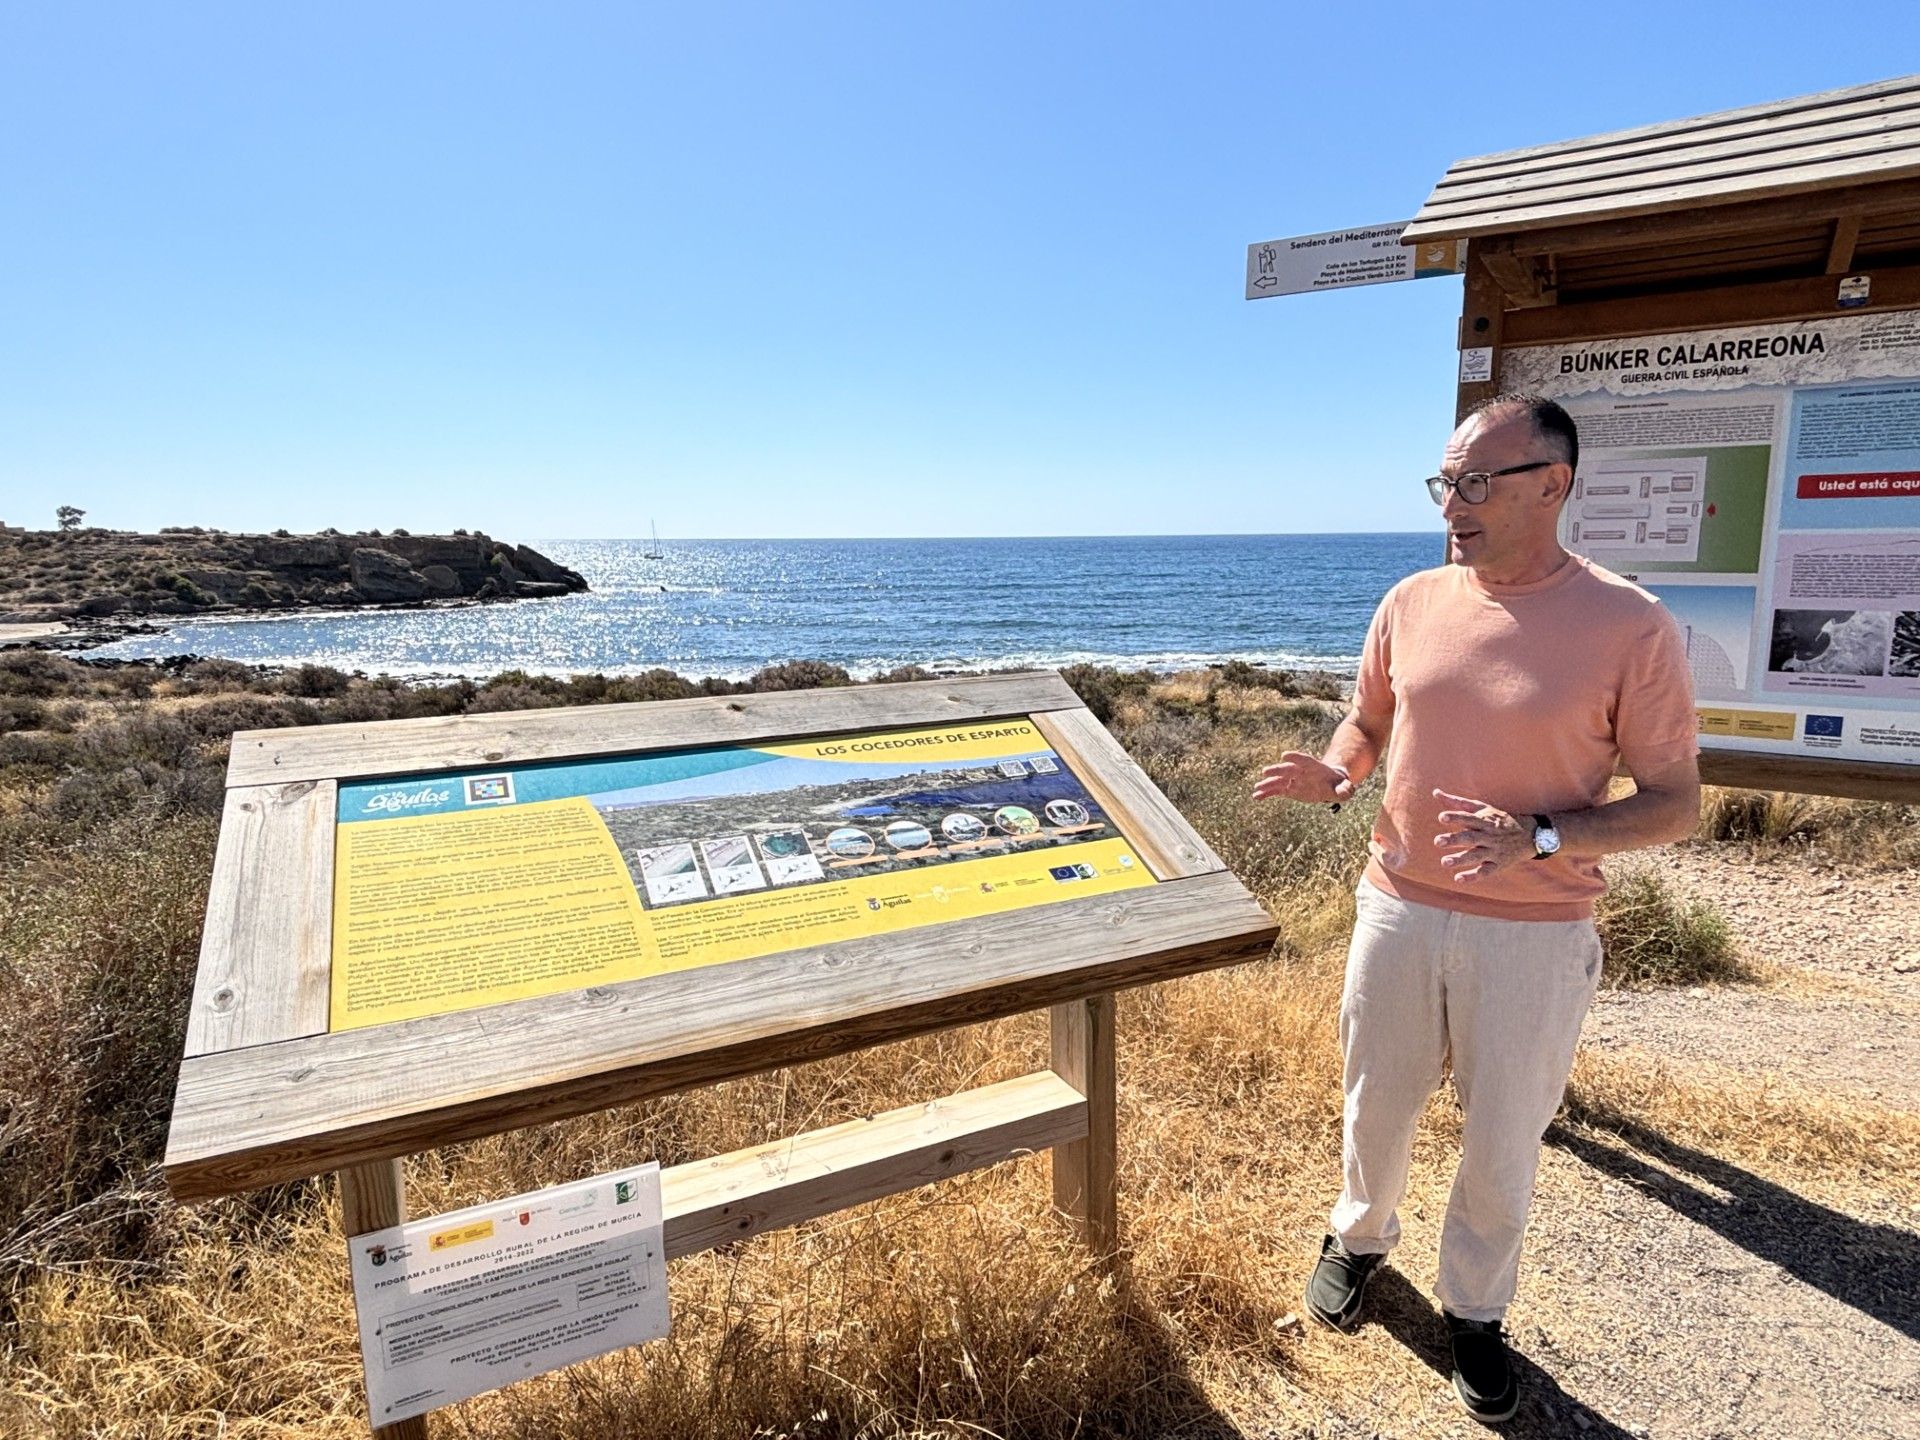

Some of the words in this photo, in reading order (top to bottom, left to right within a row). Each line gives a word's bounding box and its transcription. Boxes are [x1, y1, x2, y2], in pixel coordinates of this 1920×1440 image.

[1291, 238, 1326, 250] Sendero
[1329, 234, 1343, 245] del
[1326, 262, 1339, 270] Cala
[1359, 258, 1384, 266] Tortugas
[1321, 270, 1337, 278] Playa
[1314, 278, 1330, 287] Playa
[1560, 349, 1650, 374] BÚNKER
[1657, 333, 1825, 366] CALARREONA
[1621, 372, 1662, 384] GUERRA
[1664, 369, 1690, 380] CIVIL
[1693, 365, 1749, 379] ESPAÑOLA
[1819, 480, 1856, 490] Usted
[1859, 478, 1888, 489] está
[817, 746, 847, 756] LOS
[851, 736, 943, 752] COCEDORES
[969, 727, 1031, 739] ESPARTO
[882, 899, 912, 909] Águilas
[375, 1270, 425, 1288] PROGRAMA
[445, 1250, 501, 1269] DESARROLLO
[507, 1241, 532, 1252] RURAL
[565, 1225, 593, 1236] REGIÓN
[612, 1213, 640, 1224] MURCIA
[451, 1347, 491, 1363] PROYECTO
[495, 1329, 549, 1349] COFINANCIADO
[606, 1302, 638, 1316] EUROPEA
